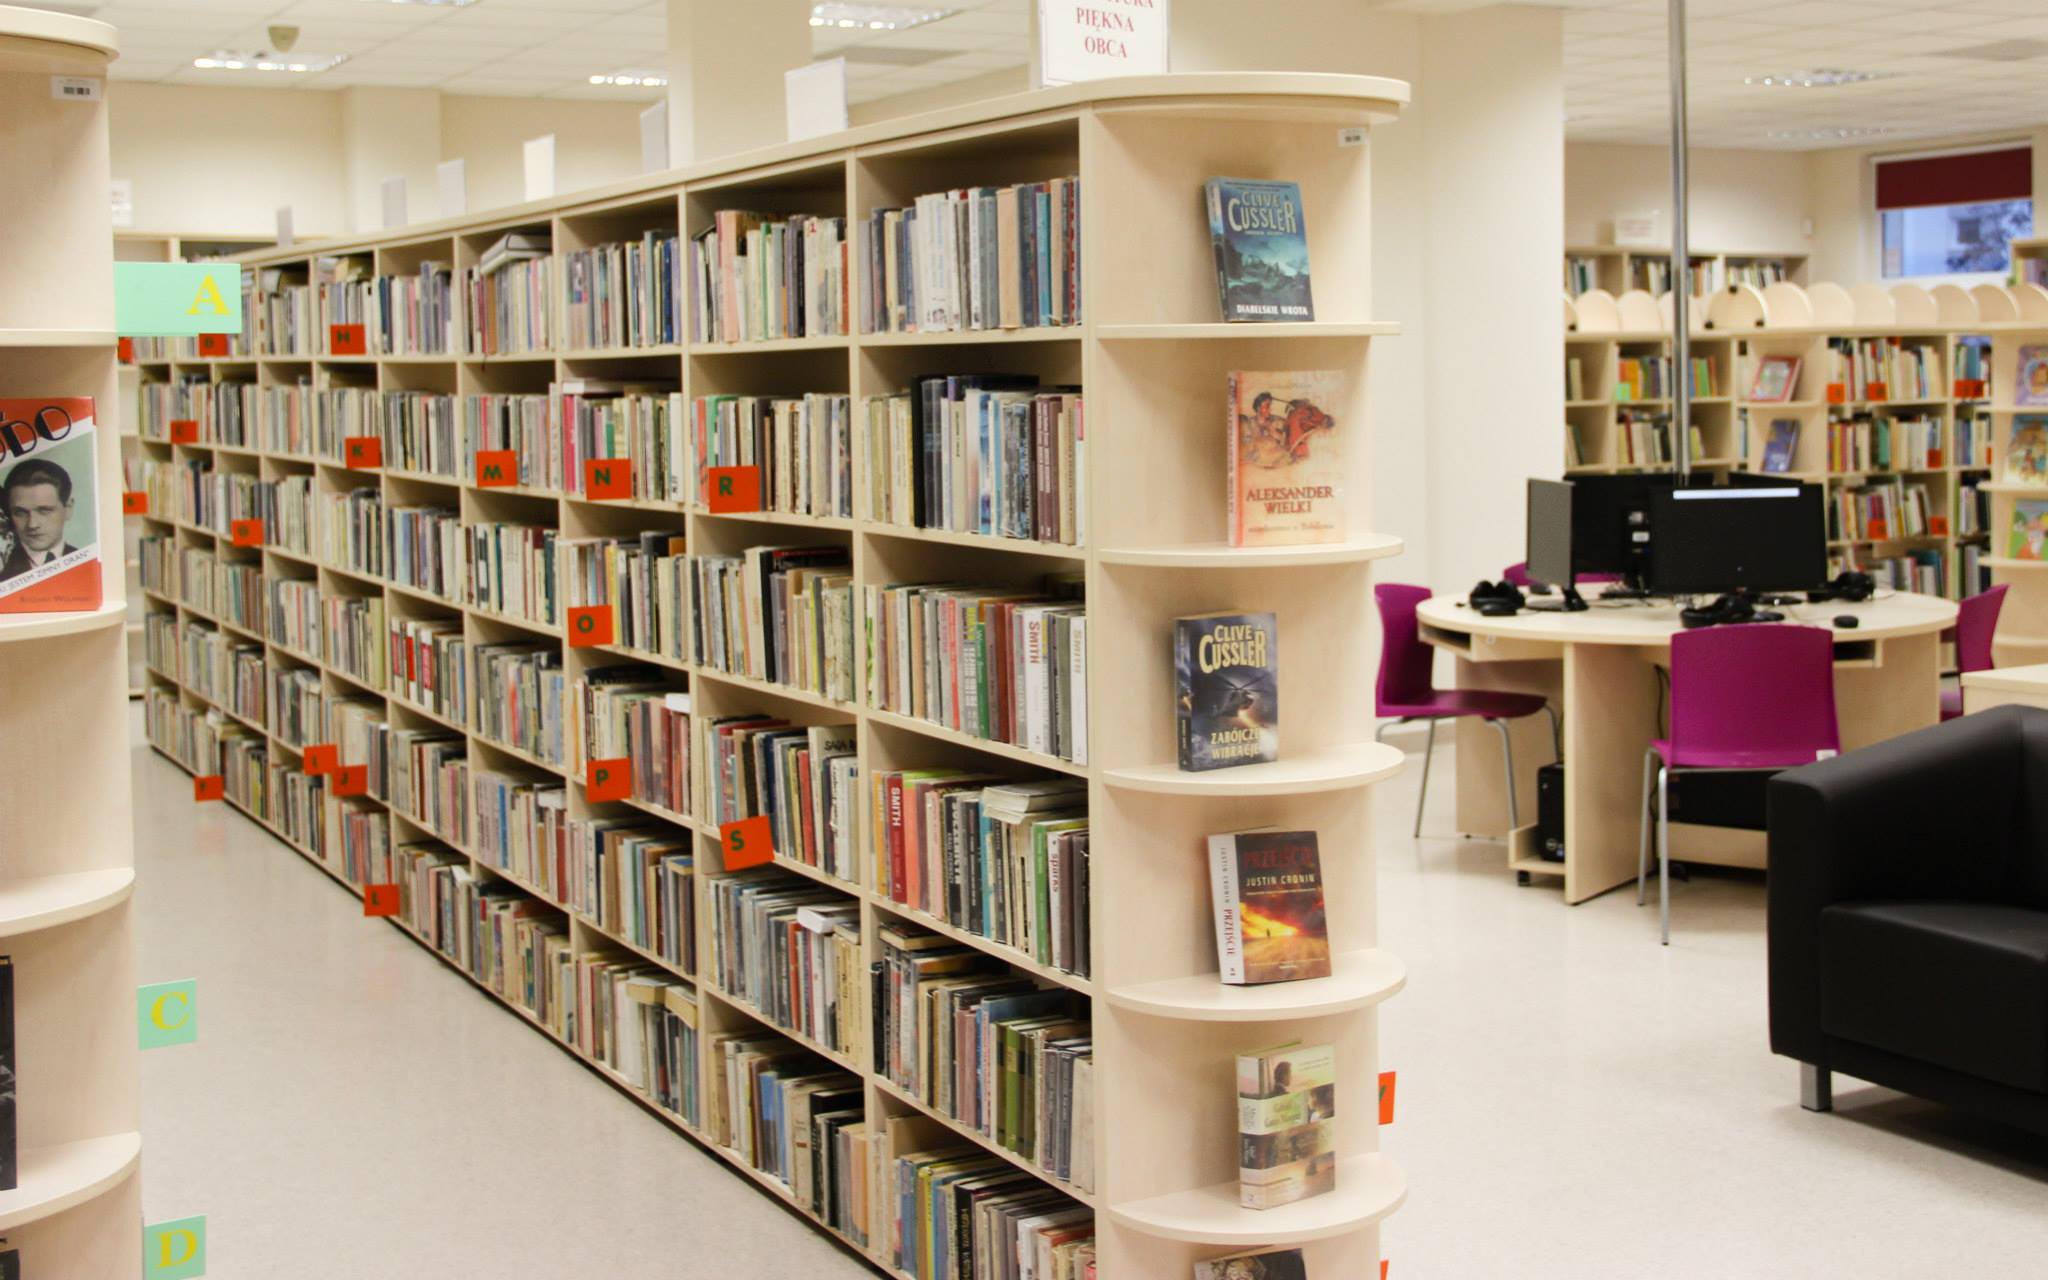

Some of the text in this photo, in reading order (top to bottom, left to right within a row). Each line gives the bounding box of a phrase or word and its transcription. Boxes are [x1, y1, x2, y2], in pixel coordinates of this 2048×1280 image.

[1077, 7, 1135, 33] PIĘKNA
[1084, 36, 1128, 59] OBCA
[1242, 191, 1281, 207] CLIVE
[1228, 198, 1297, 234] CUSSLER
[185, 273, 233, 316] A
[1236, 304, 1279, 315] DIABELSKIE
[336, 329, 351, 344] H
[483, 464, 502, 480] M
[594, 466, 611, 486] N
[718, 475, 733, 496] R
[1246, 486, 1335, 502] ALEKSANDER
[1264, 501, 1313, 514] WIELKI
[576, 614, 594, 634] O
[1214, 625, 1253, 642] CLIVE
[1029, 621, 1040, 664] SMITH
[1199, 630, 1267, 674] CUSSLER
[595, 768, 609, 786] P
[891, 787, 901, 826] SMITH
[729, 830, 745, 851] S
[1246, 873, 1315, 888] JUSTIN CRONIN
[151, 991, 190, 1031] C
[156, 1229, 198, 1269] D
